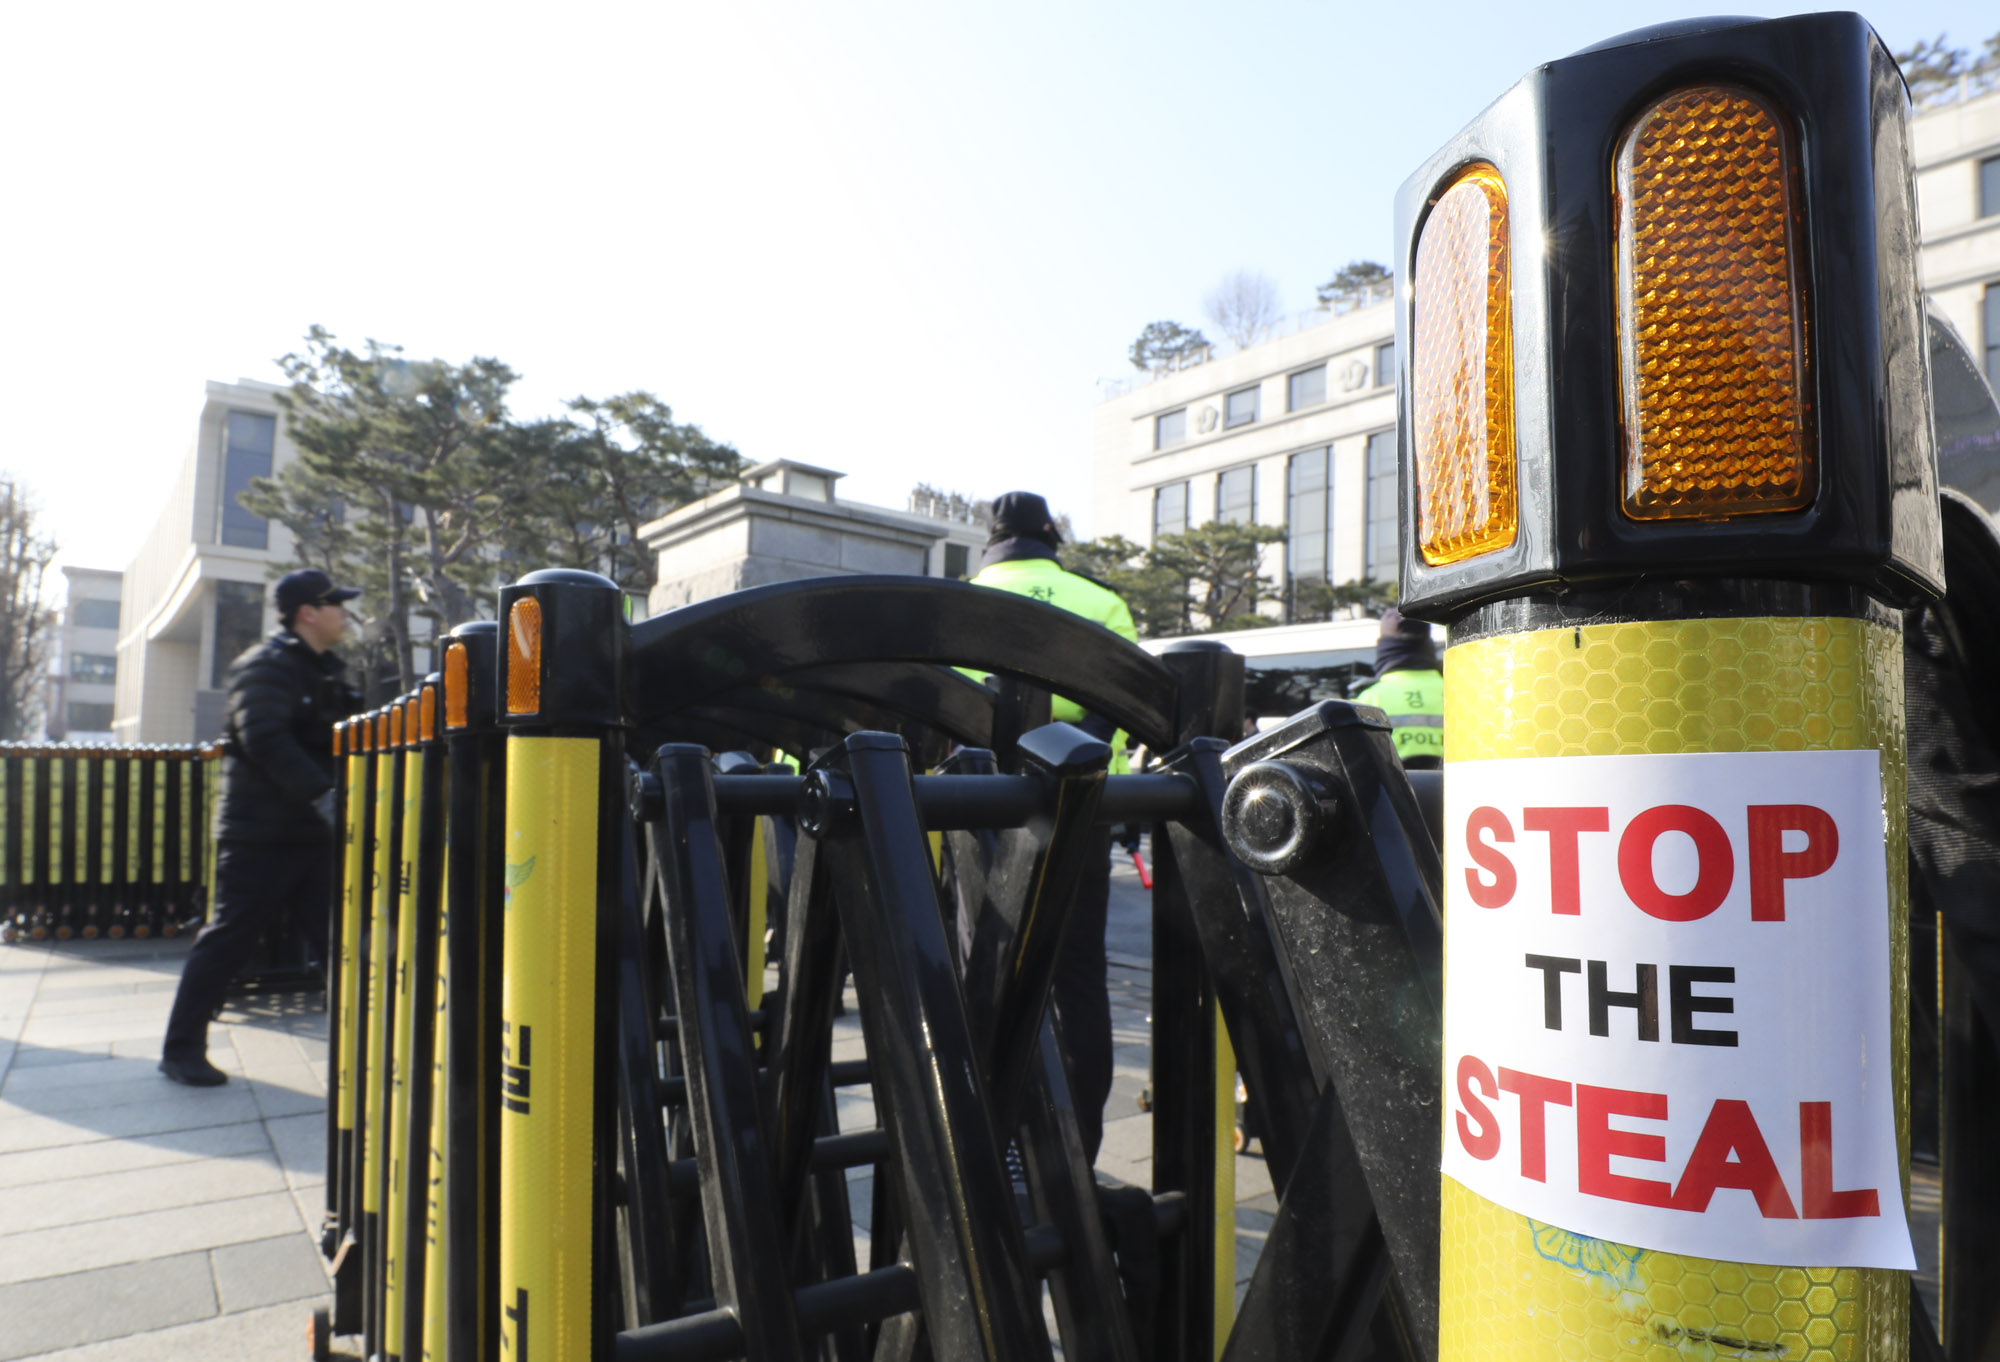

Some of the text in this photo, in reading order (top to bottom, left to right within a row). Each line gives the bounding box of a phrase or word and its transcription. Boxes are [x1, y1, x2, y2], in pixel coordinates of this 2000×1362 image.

[1464, 804, 1839, 922] STOP
[1525, 953, 1739, 1047] THE
[1455, 1054, 1881, 1220] STEAL
